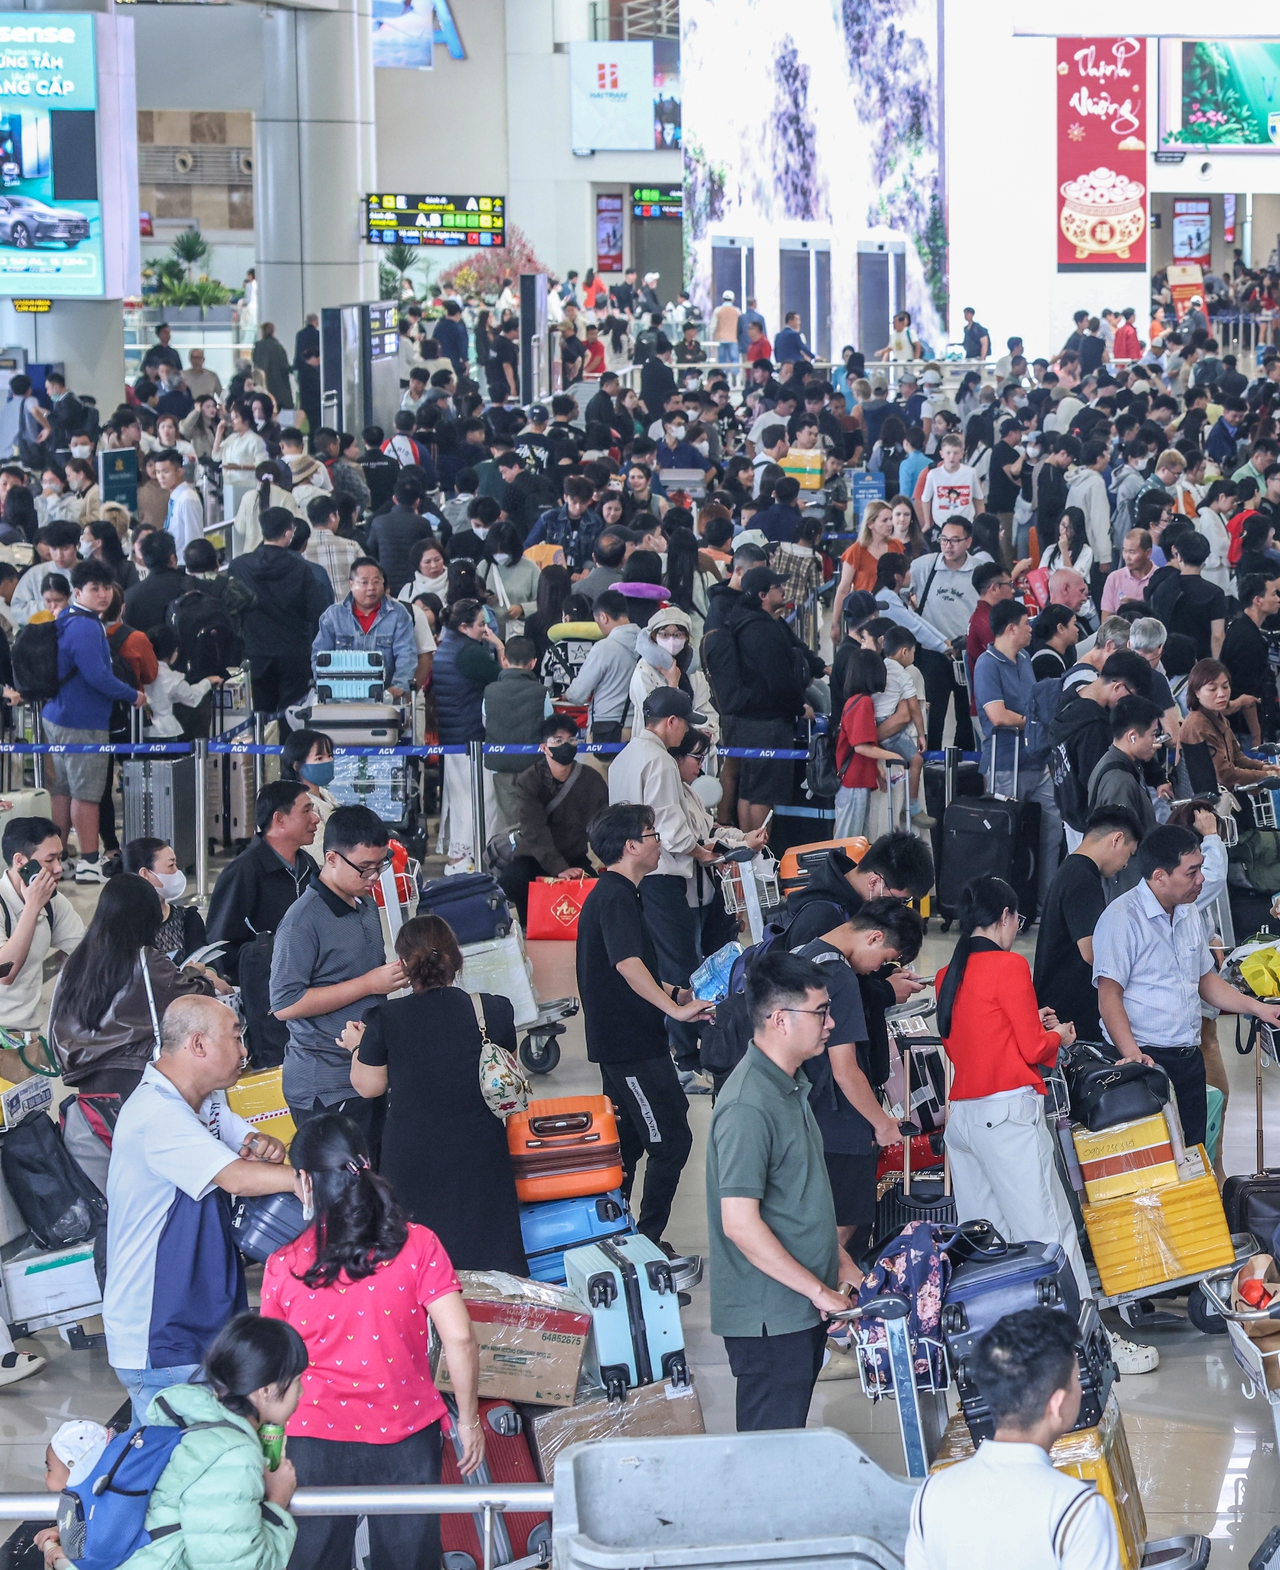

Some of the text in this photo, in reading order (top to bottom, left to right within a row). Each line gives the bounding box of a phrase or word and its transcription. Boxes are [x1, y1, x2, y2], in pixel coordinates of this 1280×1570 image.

[1073, 44, 1132, 84] Thịnh
[36, 74, 75, 96] CẤP
[466, 196, 478, 211] A
[333, 747, 346, 755] CV
[557, 900, 577, 916] An
